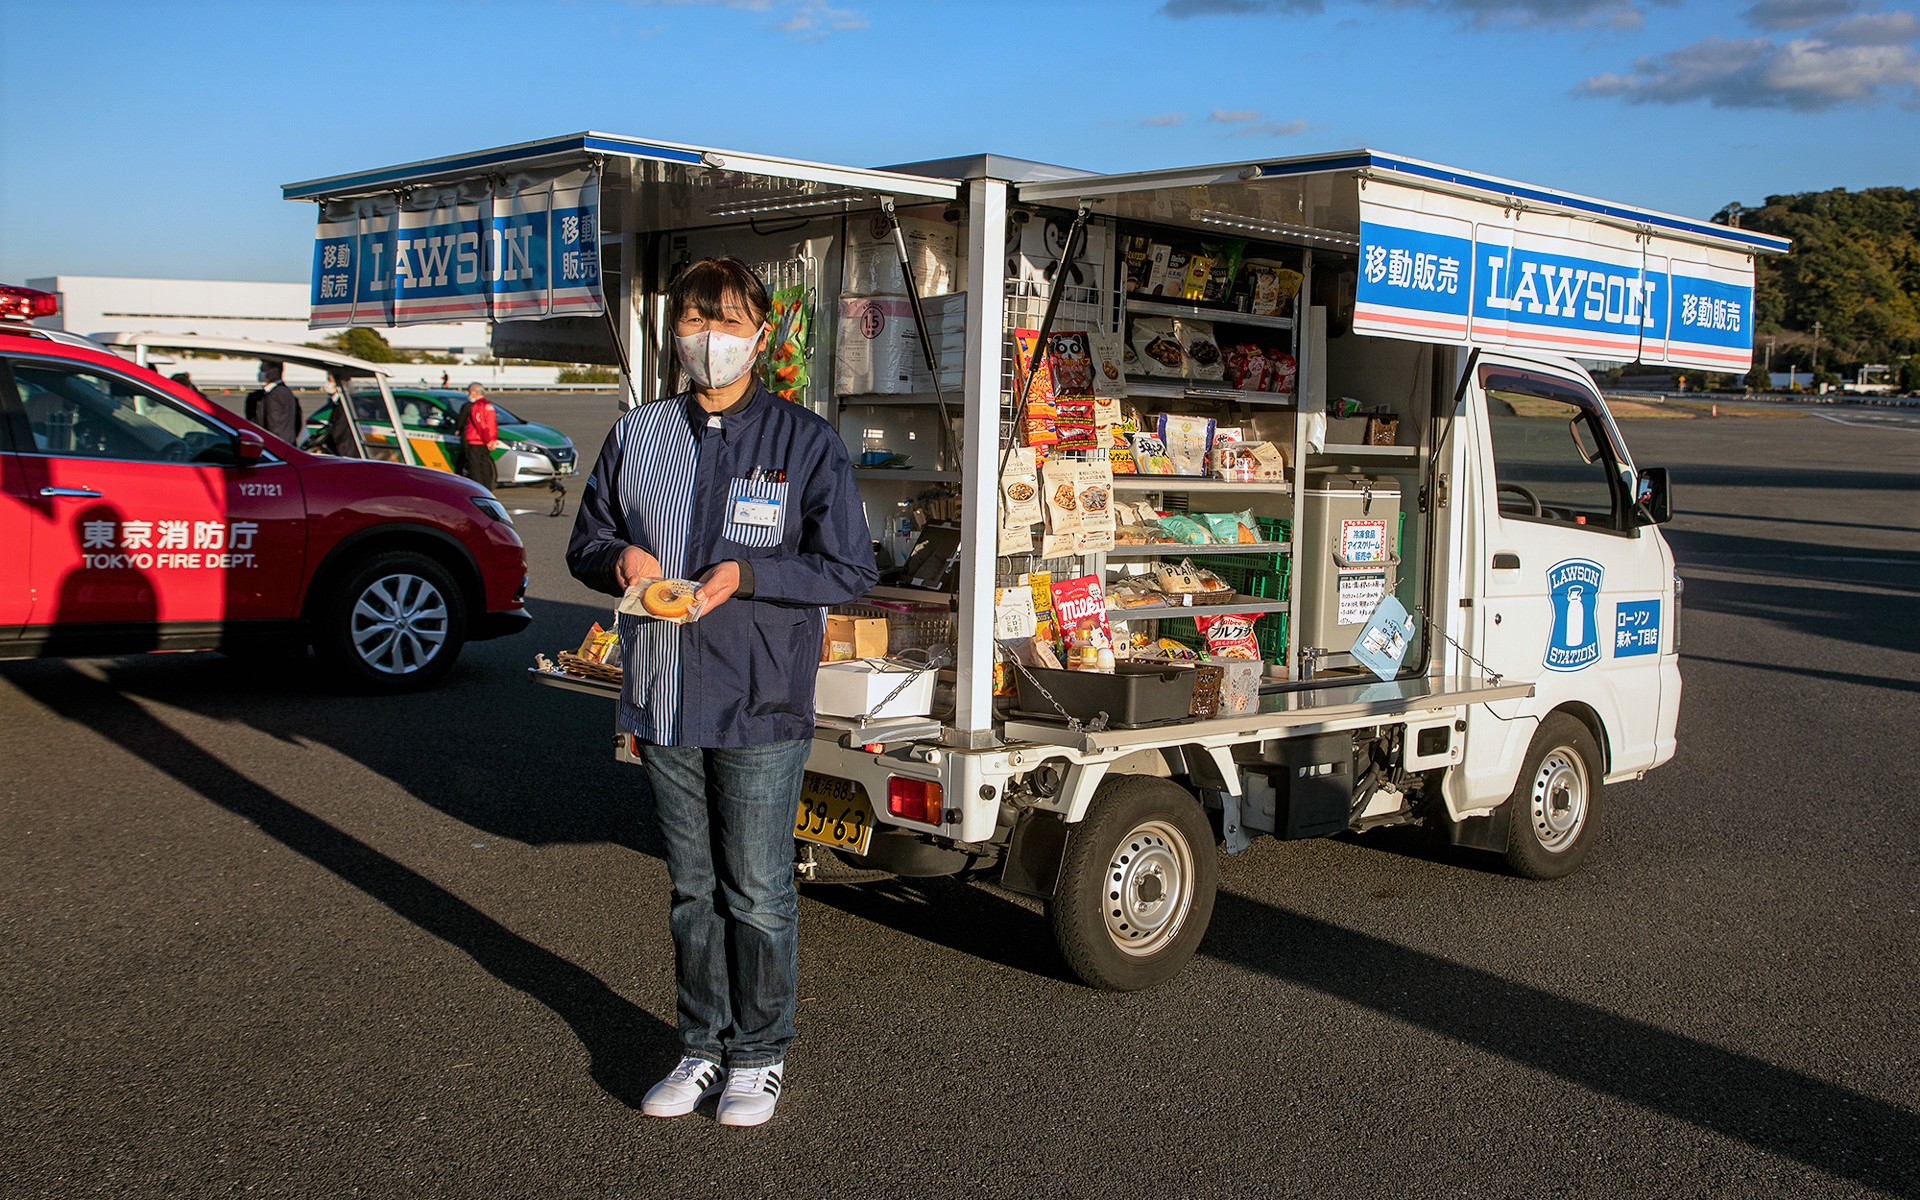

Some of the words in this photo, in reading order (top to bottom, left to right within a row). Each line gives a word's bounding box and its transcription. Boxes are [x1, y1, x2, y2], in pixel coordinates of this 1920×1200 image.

[562, 214, 598, 246] 移動
[323, 243, 350, 269] 移動
[369, 224, 533, 292] LAWSON
[562, 250, 598, 281] 販売
[1364, 243, 1460, 296] 移動販売
[320, 274, 348, 299] 販売
[1486, 255, 1656, 329] LAWSON
[864, 316, 880, 329] 1.5
[1681, 293, 1741, 332] 移動販売
[238, 483, 283, 497] Y27121
[82, 519, 259, 550] 東京消防庁
[1347, 540, 1380, 550] アイスクリーム
[82, 553, 156, 569] TOKYO
[156, 553, 201, 569] FIRE
[205, 553, 259, 569] DEPT.
[1354, 551, 1372, 561] 販売中
[1551, 565, 1600, 589] LAWSON
[1058, 596, 1106, 622] Milky
[1617, 610, 1650, 627] ローソン
[1549, 641, 1597, 665] STATION
[796, 797, 865, 844] 39-63
